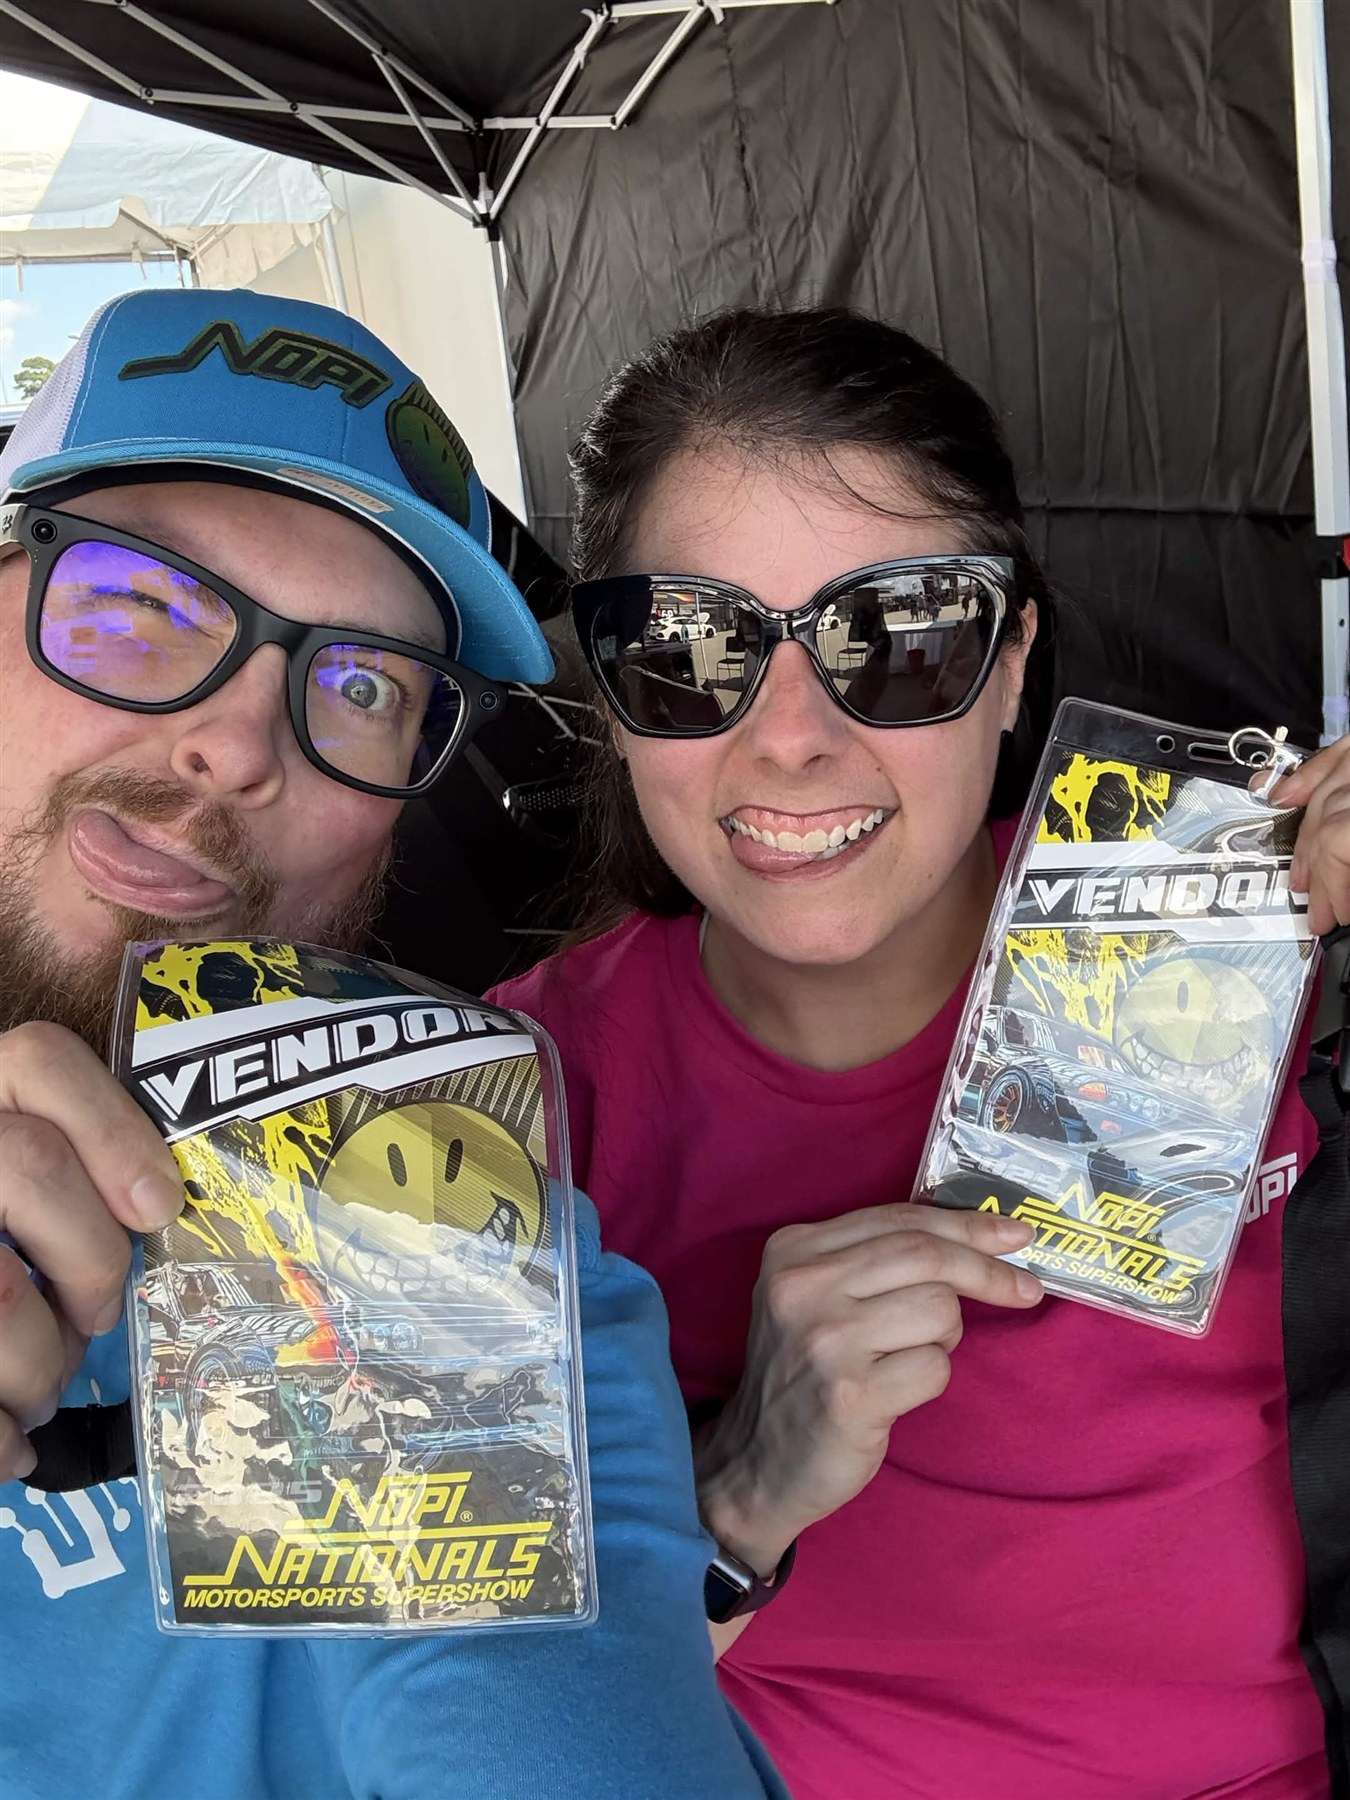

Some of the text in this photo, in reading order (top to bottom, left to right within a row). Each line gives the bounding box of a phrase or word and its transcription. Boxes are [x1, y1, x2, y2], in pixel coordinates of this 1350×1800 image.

[118, 320, 394, 409] NOPI
[139, 1007, 517, 1121] VENDOR
[1244, 1152, 1297, 1224] OPI
[1065, 1260, 1181, 1304] SUPERSHOW
[183, 1521, 552, 1586] NATIONALS
[183, 1579, 535, 1609] MOTORSPORTS SUPERSHOW
